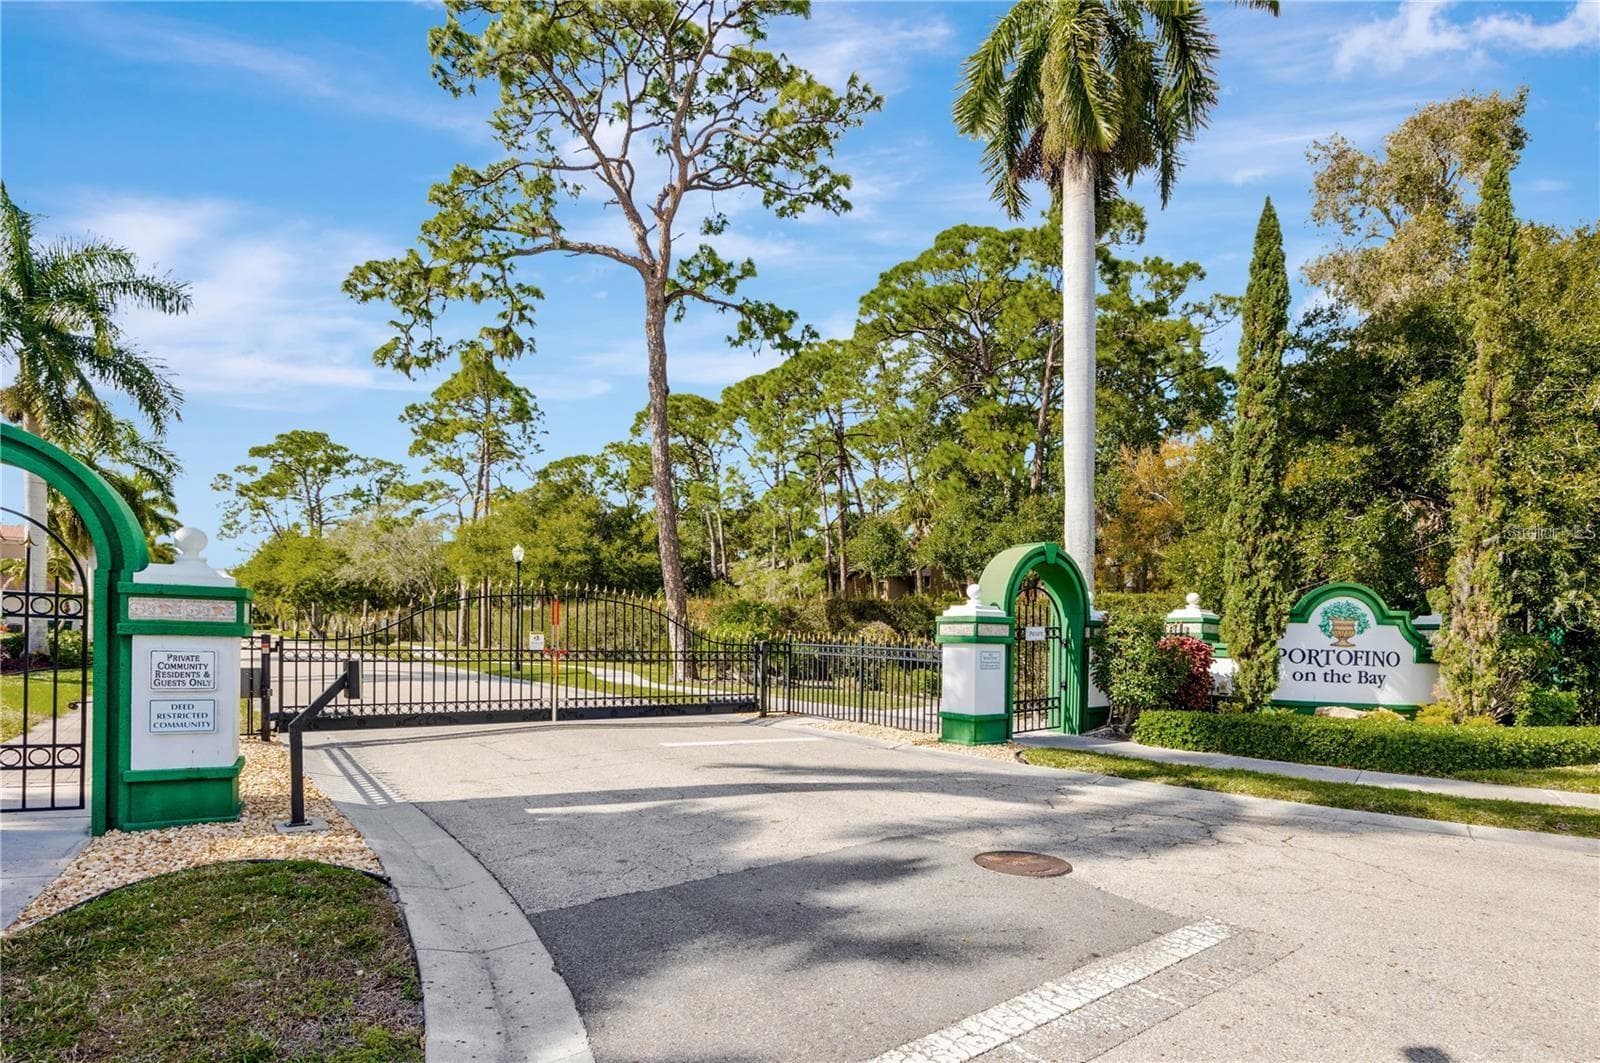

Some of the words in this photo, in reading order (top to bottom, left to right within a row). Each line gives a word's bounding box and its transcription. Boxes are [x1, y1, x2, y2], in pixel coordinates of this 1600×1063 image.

[167, 653, 200, 662] PRIVATE
[1277, 647, 1401, 668] PORTOFINO
[157, 661, 209, 670] COMMUNITY
[155, 670, 201, 679] RESIDENTS
[203, 671, 211, 679] &
[1292, 670, 1316, 682] on
[1323, 669, 1352, 684] the
[1357, 670, 1386, 689] Bay
[153, 678, 187, 687] GUESTS
[189, 678, 212, 687] ONLY
[171, 703, 195, 711] DEED
[156, 712, 209, 720] RESTRICTED
[153, 721, 211, 729] COMMUNITY
